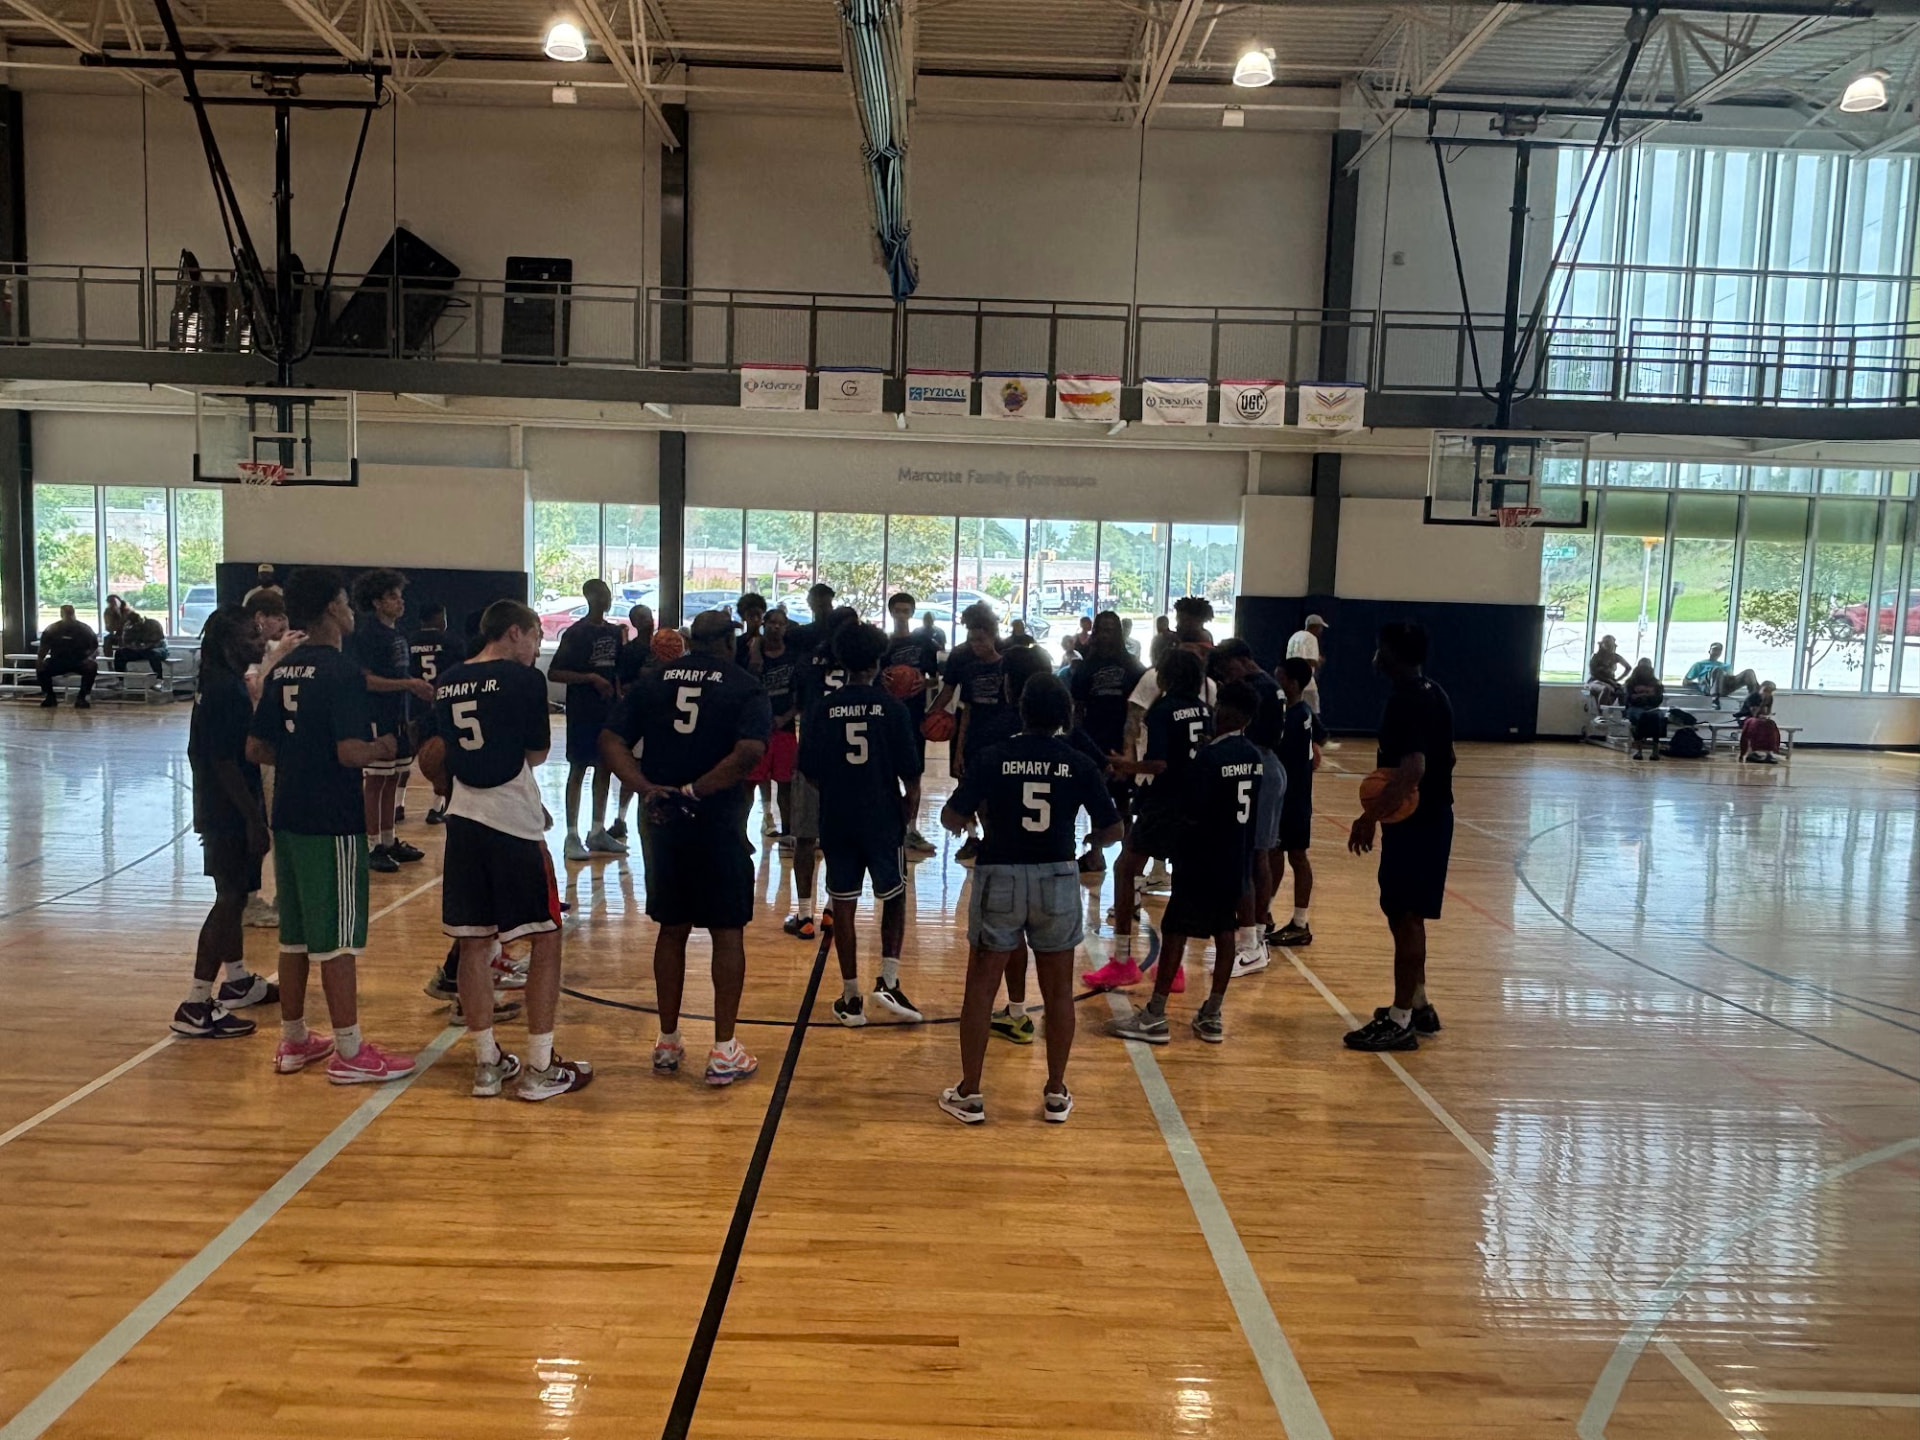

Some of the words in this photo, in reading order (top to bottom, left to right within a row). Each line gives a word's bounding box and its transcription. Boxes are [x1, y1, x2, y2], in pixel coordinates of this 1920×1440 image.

[760, 380, 803, 391] Advance
[923, 387, 966, 398] FYZICAL
[1241, 394, 1263, 411] UGC
[898, 467, 962, 484] Marcotte
[967, 469, 1012, 487] Family
[420, 655, 437, 681] 5
[664, 669, 707, 683] DEMARY
[707, 670, 723, 683] JR.
[436, 681, 478, 700] DEMARY
[481, 679, 500, 692] JR.
[674, 686, 702, 734] 5
[829, 704, 867, 719] DEMARY
[869, 704, 885, 717] JR.
[1173, 707, 1200, 721] DEMARY
[452, 700, 485, 751] 5
[846, 722, 868, 765] 5
[1002, 761, 1050, 776] DEMARY
[1054, 763, 1073, 778] JR.
[1221, 764, 1253, 778] DEMARY
[1022, 782, 1051, 832] 5
[1236, 780, 1252, 824] 5
